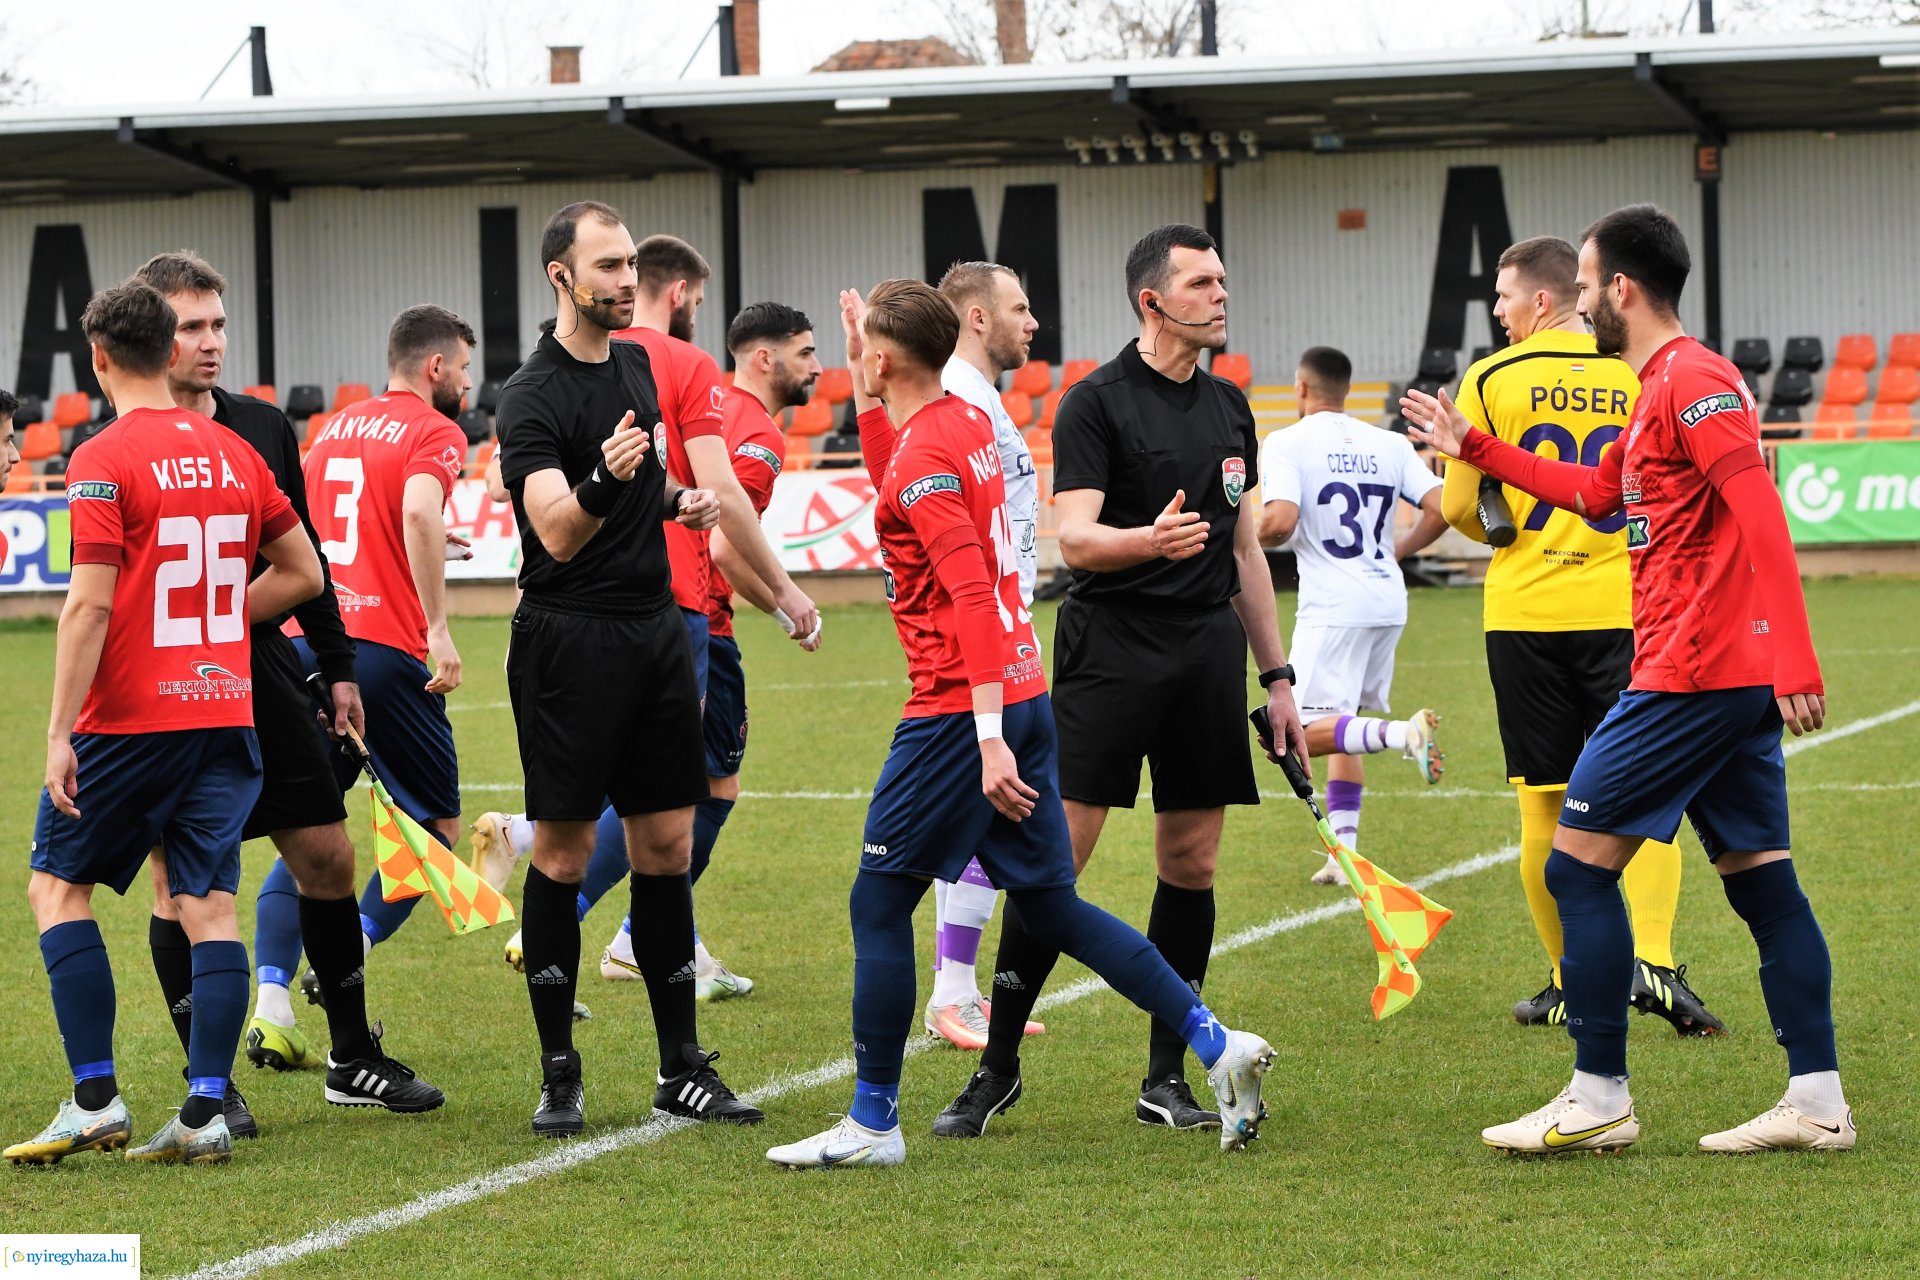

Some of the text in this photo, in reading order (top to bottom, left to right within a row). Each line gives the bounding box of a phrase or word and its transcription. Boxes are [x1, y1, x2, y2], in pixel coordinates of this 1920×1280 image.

[1699, 147, 1717, 170] E
[14, 225, 108, 400] A
[1421, 166, 1513, 352] A
[1530, 378, 1628, 417] PÓSER
[315, 413, 408, 445] JÁNVÁRI
[151, 451, 246, 491] KISS Á.
[320, 457, 365, 566] 3
[1317, 481, 1395, 560] 37
[153, 514, 249, 648] 26
[158, 680, 219, 695] LERTON
[1564, 798, 1590, 813] JAKO
[864, 843, 887, 856] JAKO
[531, 976, 569, 985] adidas
